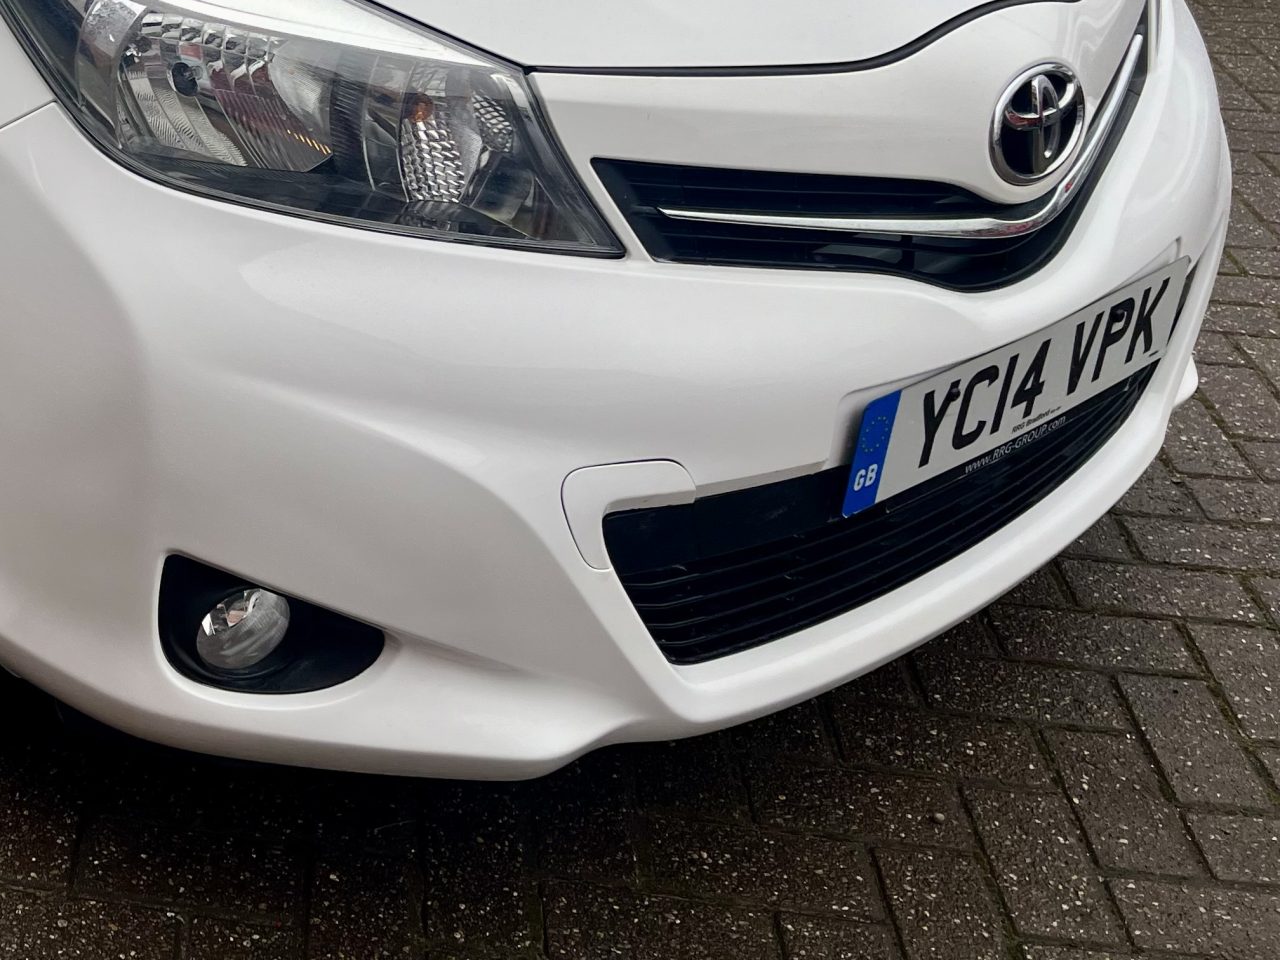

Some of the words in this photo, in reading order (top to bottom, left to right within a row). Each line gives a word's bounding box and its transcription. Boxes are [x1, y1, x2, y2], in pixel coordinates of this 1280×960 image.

[918, 339, 1052, 468] YC14
[1066, 276, 1171, 397] VPK
[853, 463, 878, 491] GB
